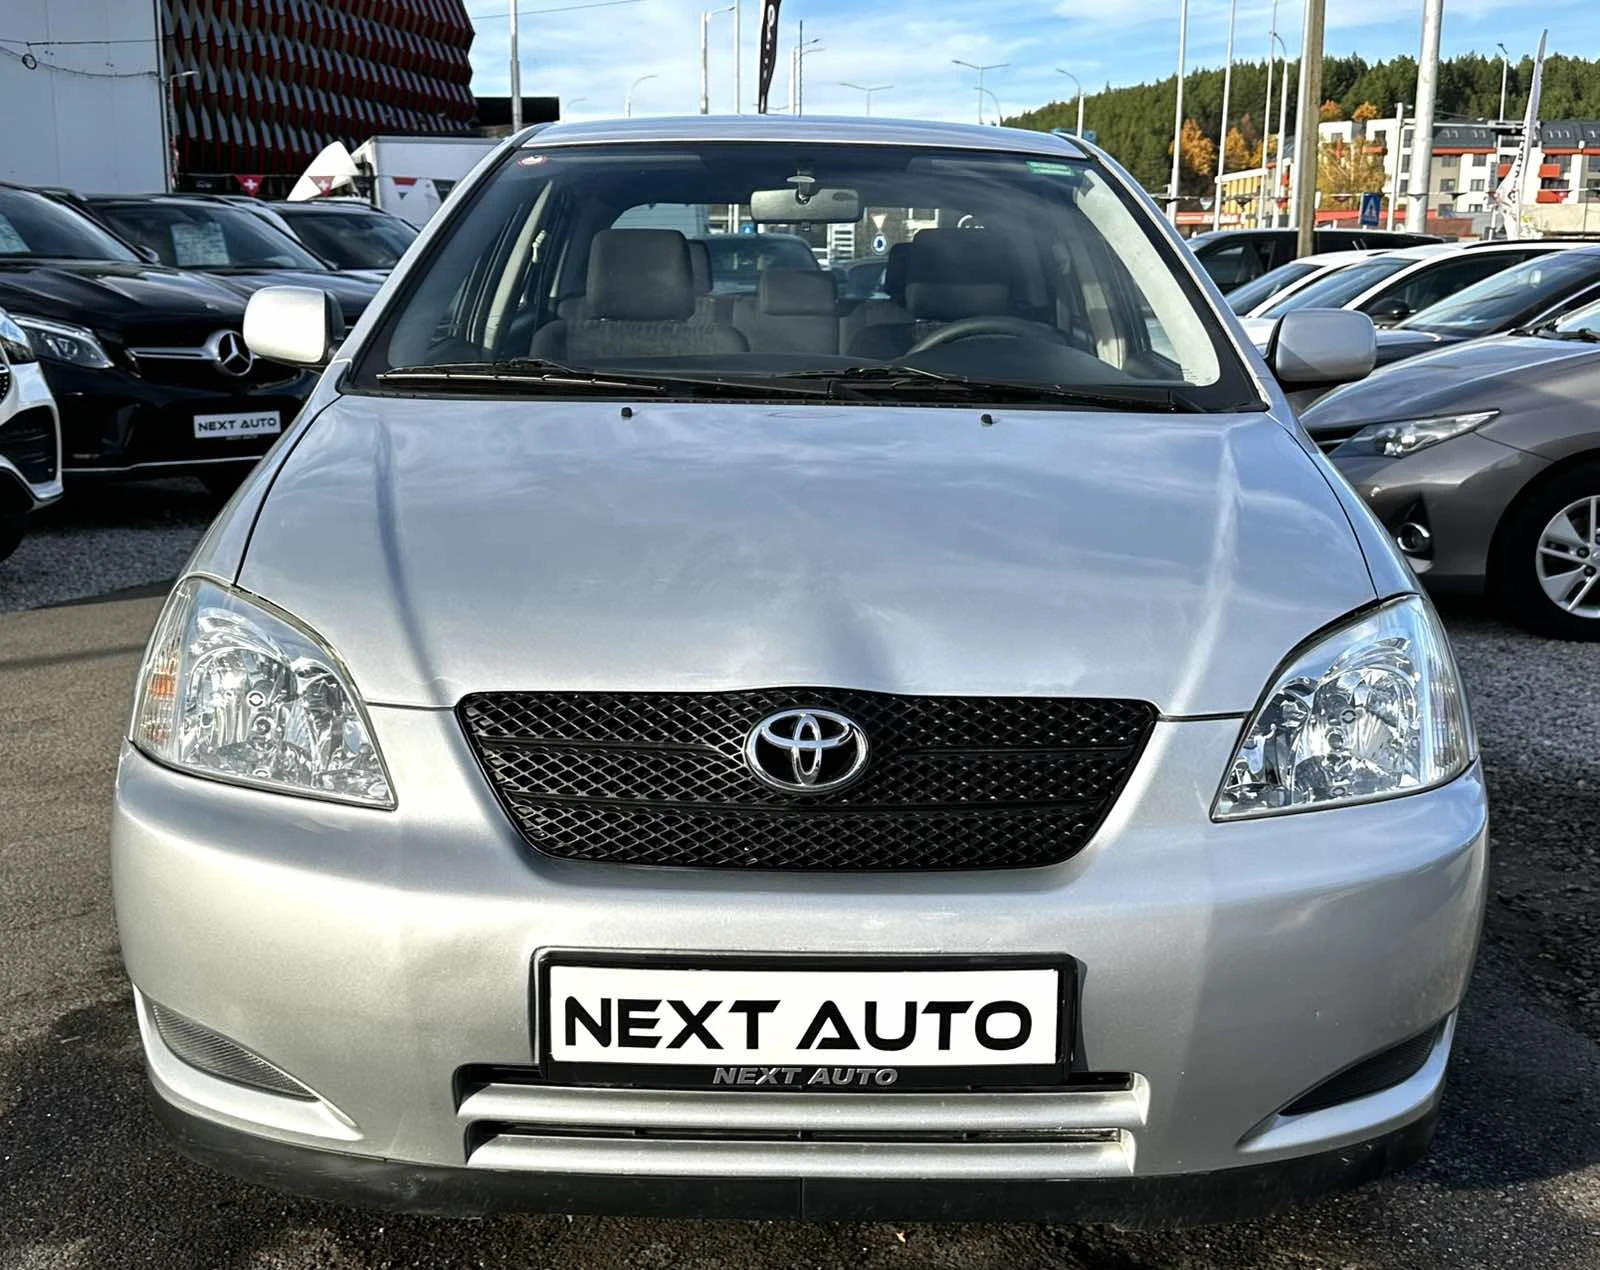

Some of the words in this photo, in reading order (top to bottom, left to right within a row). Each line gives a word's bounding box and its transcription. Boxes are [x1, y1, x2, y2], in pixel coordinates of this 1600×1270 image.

[198, 420, 236, 431] NEXT
[240, 417, 276, 428] AUTO
[564, 995, 781, 1050] NEXT
[795, 999, 1033, 1052] AUTO
[712, 1067, 802, 1085] NEXT
[807, 1067, 898, 1085] AUTO
